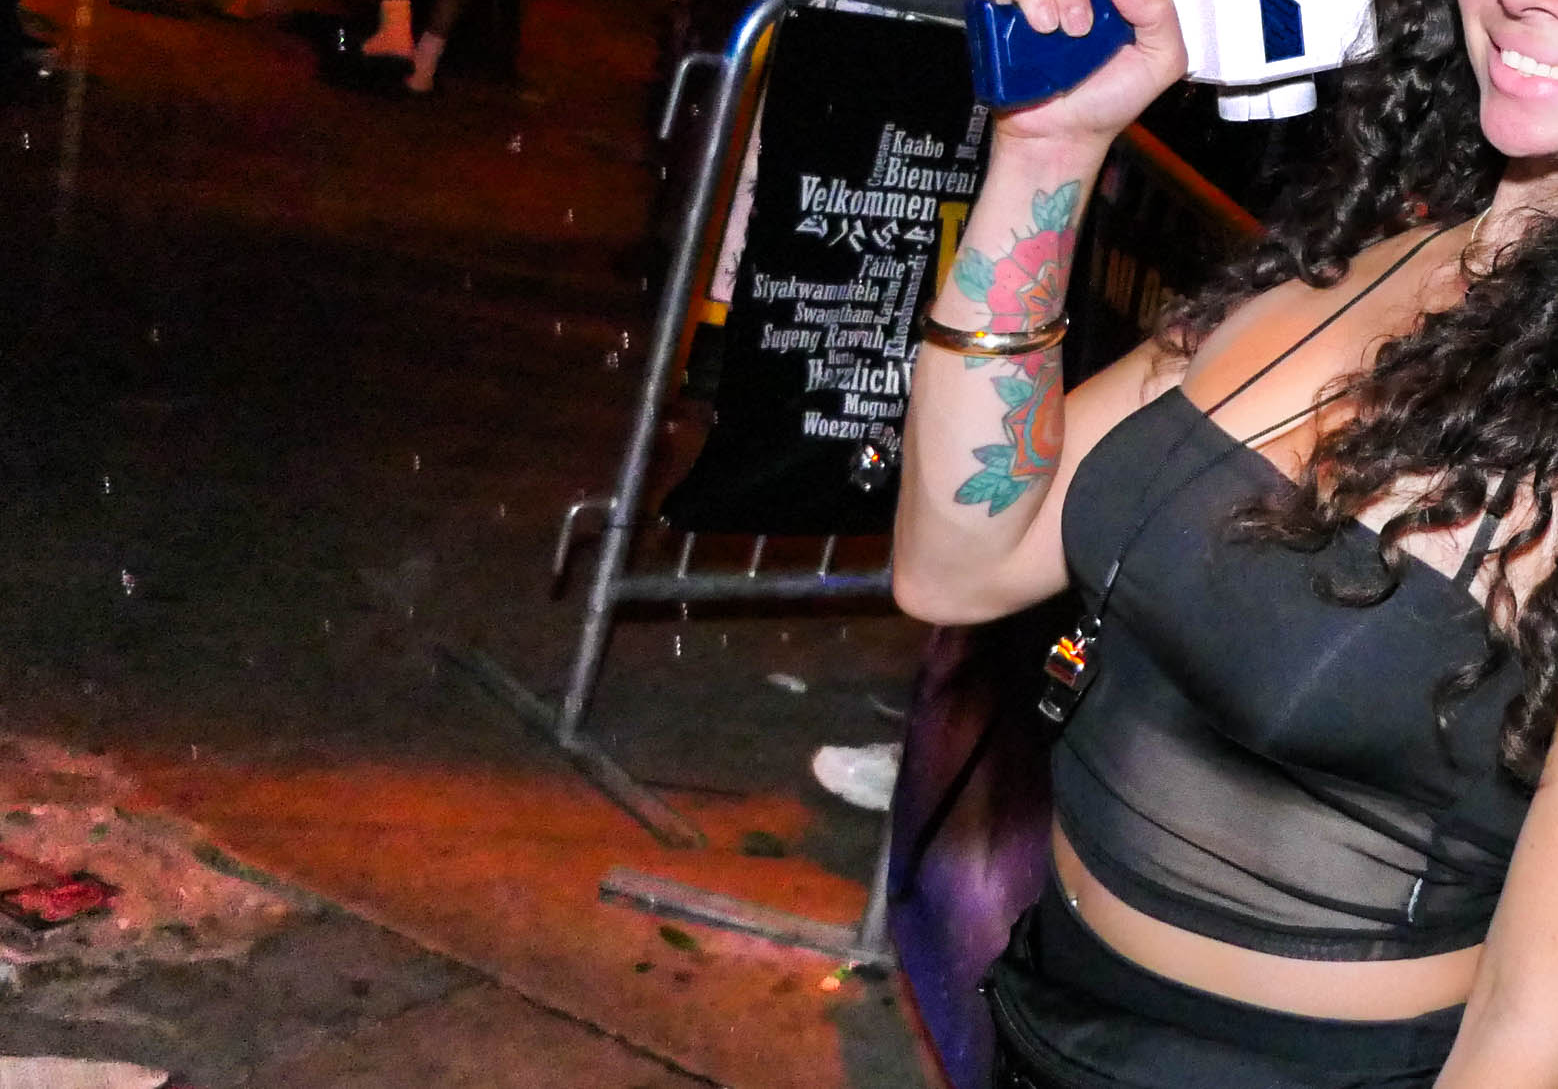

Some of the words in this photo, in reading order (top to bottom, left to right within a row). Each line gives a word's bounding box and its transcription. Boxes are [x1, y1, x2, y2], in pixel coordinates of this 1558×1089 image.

[892, 130, 945, 160] Kaabo
[799, 175, 938, 222] Velkommen
[760, 323, 822, 354] Sugeng
[824, 324, 885, 351] Rawuh
[802, 410, 869, 440] Woezor
